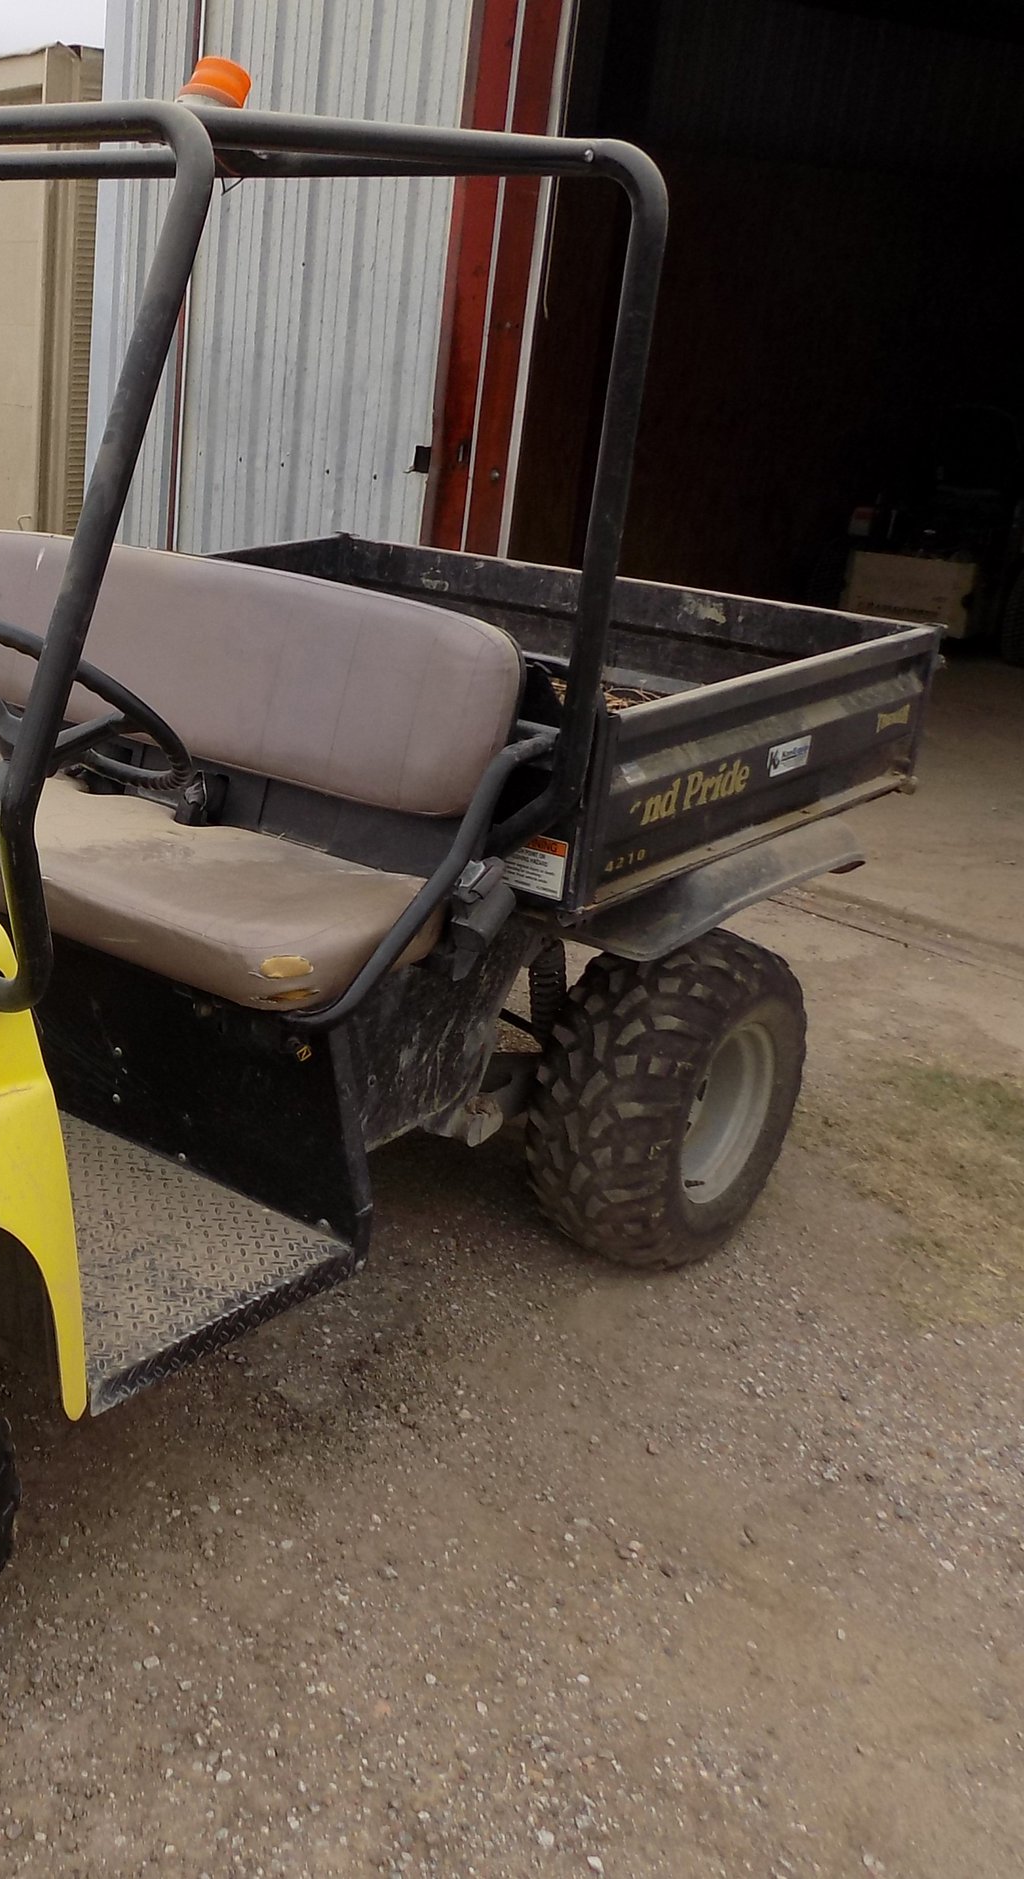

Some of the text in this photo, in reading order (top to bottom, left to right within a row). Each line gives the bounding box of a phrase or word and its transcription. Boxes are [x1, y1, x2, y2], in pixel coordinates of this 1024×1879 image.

[630, 759, 751, 826] nd Pride
[604, 849, 646, 872] 4210
